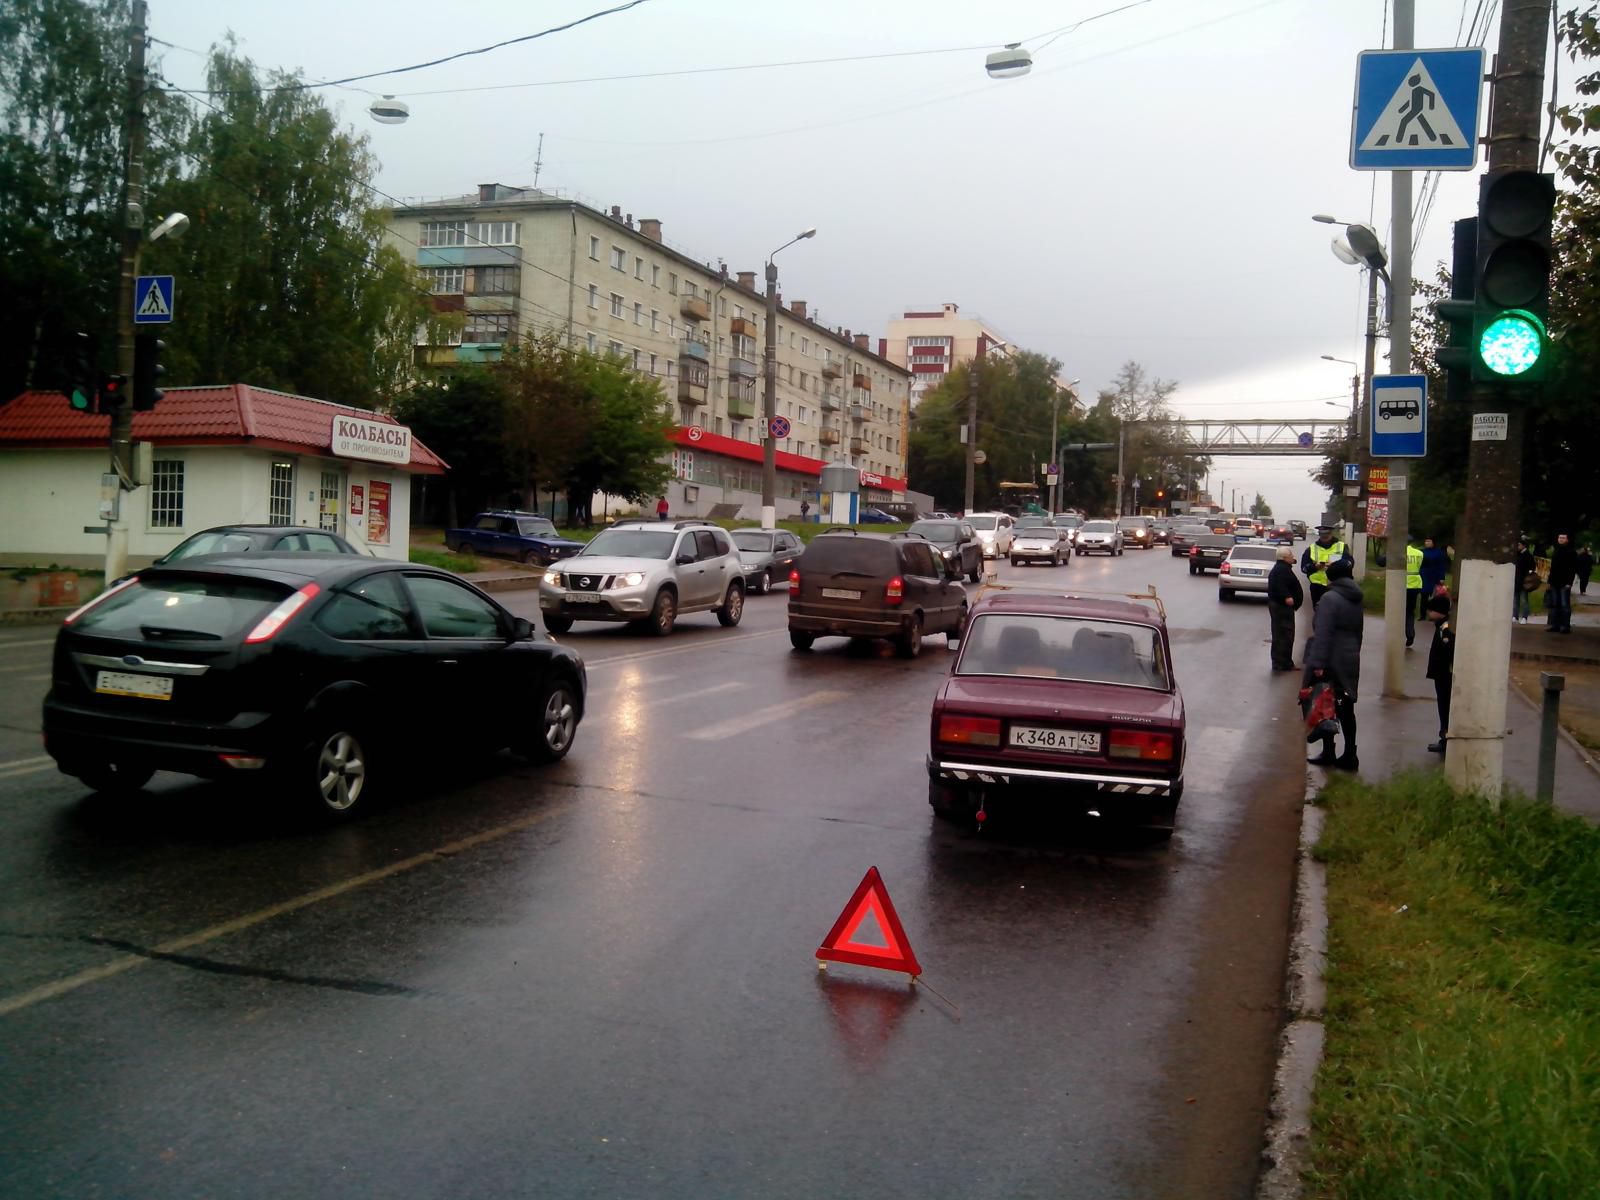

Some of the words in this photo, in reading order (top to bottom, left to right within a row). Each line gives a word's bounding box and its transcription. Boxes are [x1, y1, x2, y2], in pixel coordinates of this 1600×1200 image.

[339, 420, 407, 446] КОЛБАСЫ
[1016, 729, 1077, 748] К348АТ
[1080, 734, 1096, 745] 43
